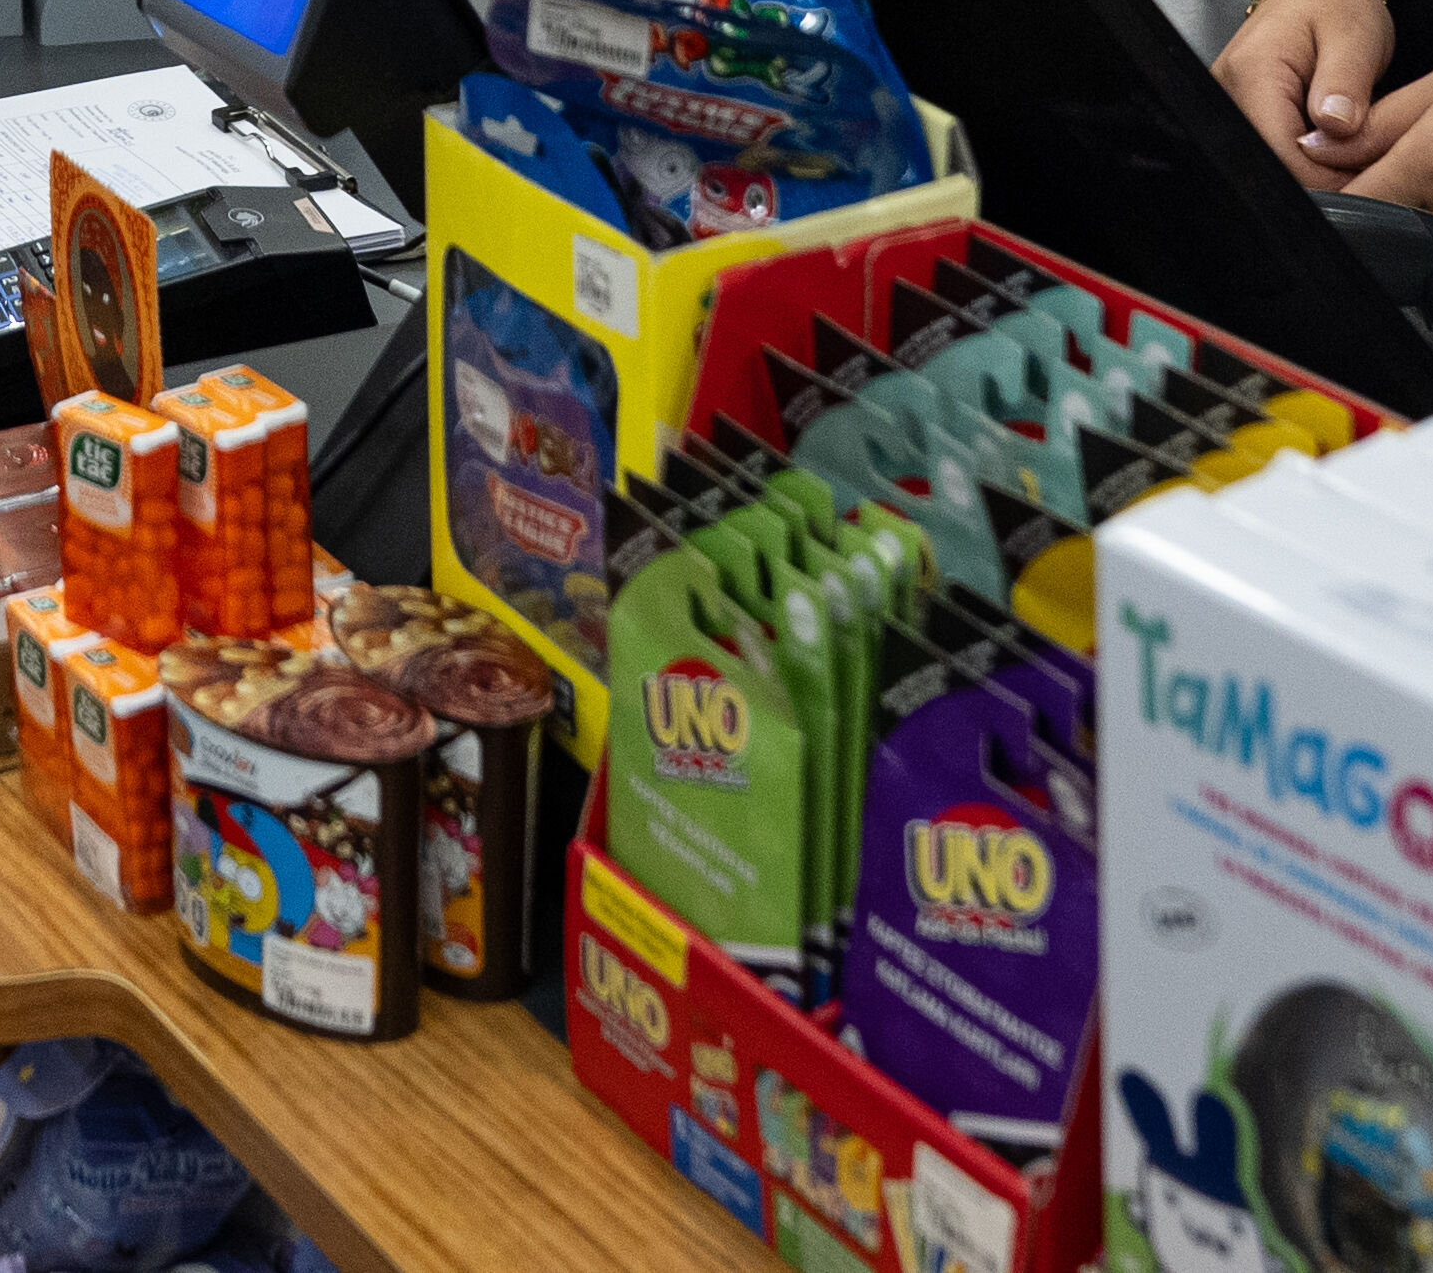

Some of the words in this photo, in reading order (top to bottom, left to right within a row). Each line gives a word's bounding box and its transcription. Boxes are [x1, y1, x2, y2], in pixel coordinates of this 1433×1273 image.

[643, 674, 750, 754] UNO
[907, 820, 1055, 914] UNO
[580, 933, 671, 1053] UNO
